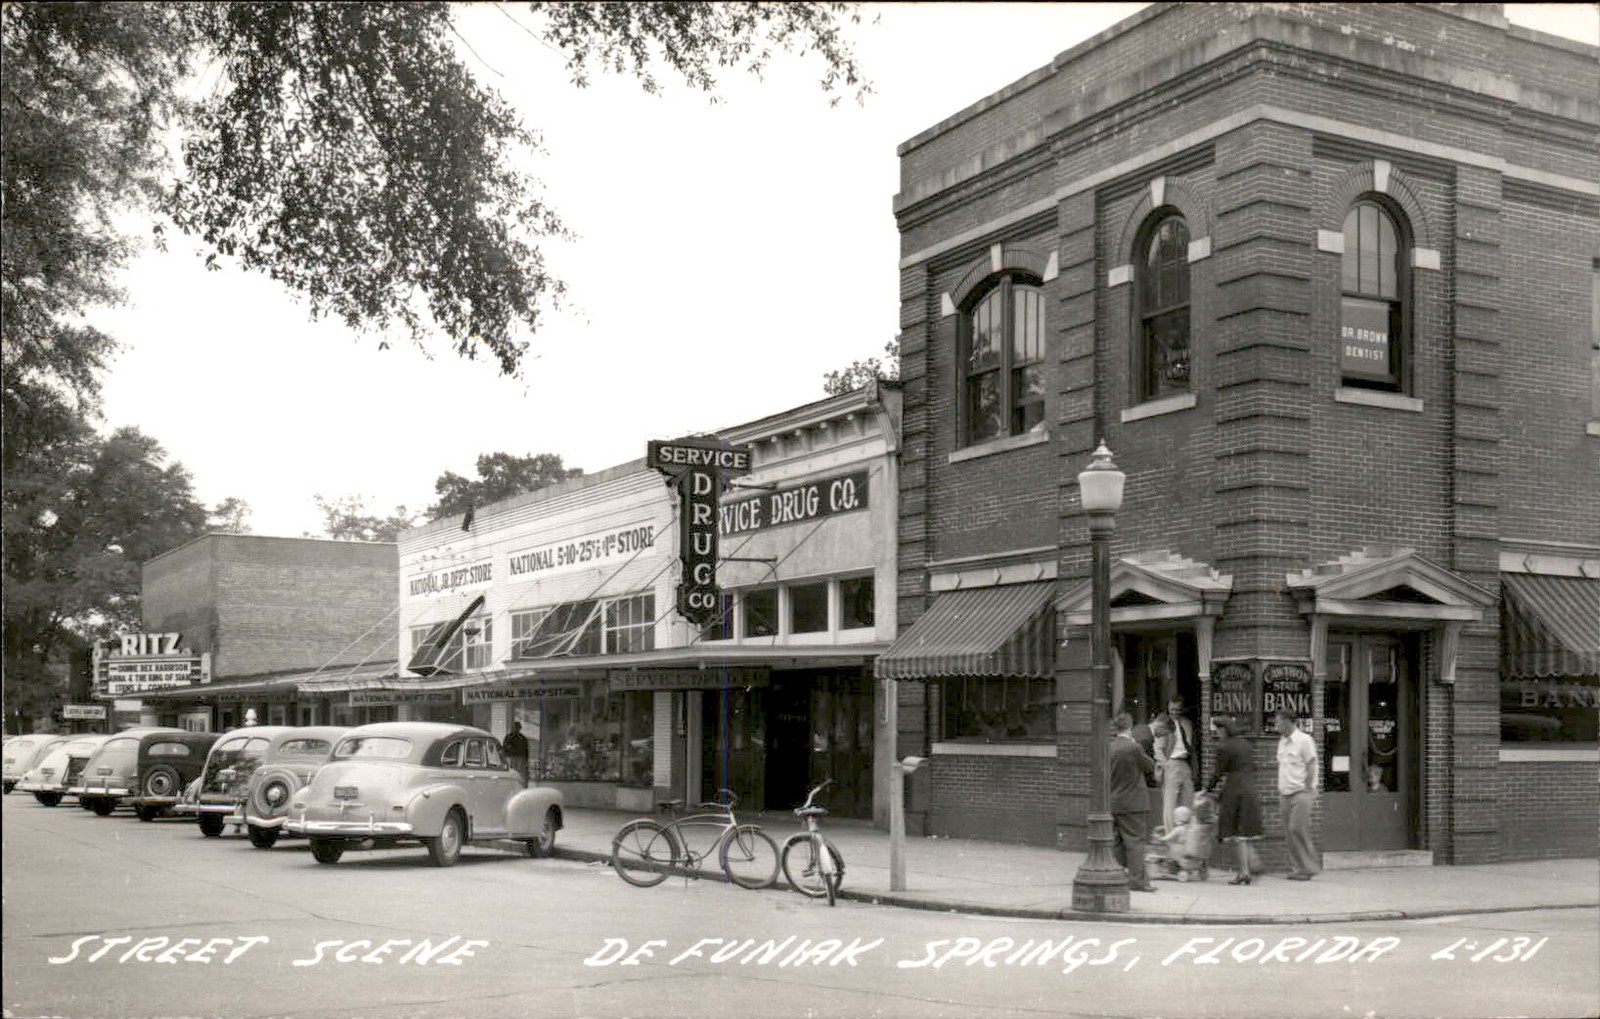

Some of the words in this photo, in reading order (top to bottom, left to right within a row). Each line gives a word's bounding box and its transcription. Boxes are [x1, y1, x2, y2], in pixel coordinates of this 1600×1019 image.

[1357, 329, 1387, 344] BROWN
[1345, 346, 1384, 360] DENTIST
[659, 446, 747, 468] SERVICE
[718, 499, 761, 535] VICE
[771, 486, 819, 525] DRUG
[830, 478, 858, 512] CO.
[693, 473, 713, 585] DRUG
[510, 548, 554, 576] NATIONAL
[618, 526, 654, 554] STORE
[470, 562, 493, 584] STORE
[689, 593, 715, 608] CO
[121, 632, 181, 656] RITZ
[155, 663, 189, 672] HARRISON
[467, 689, 515, 699] NATIONAL
[1213, 692, 1252, 713] BANK
[1264, 692, 1311, 714] BANK
